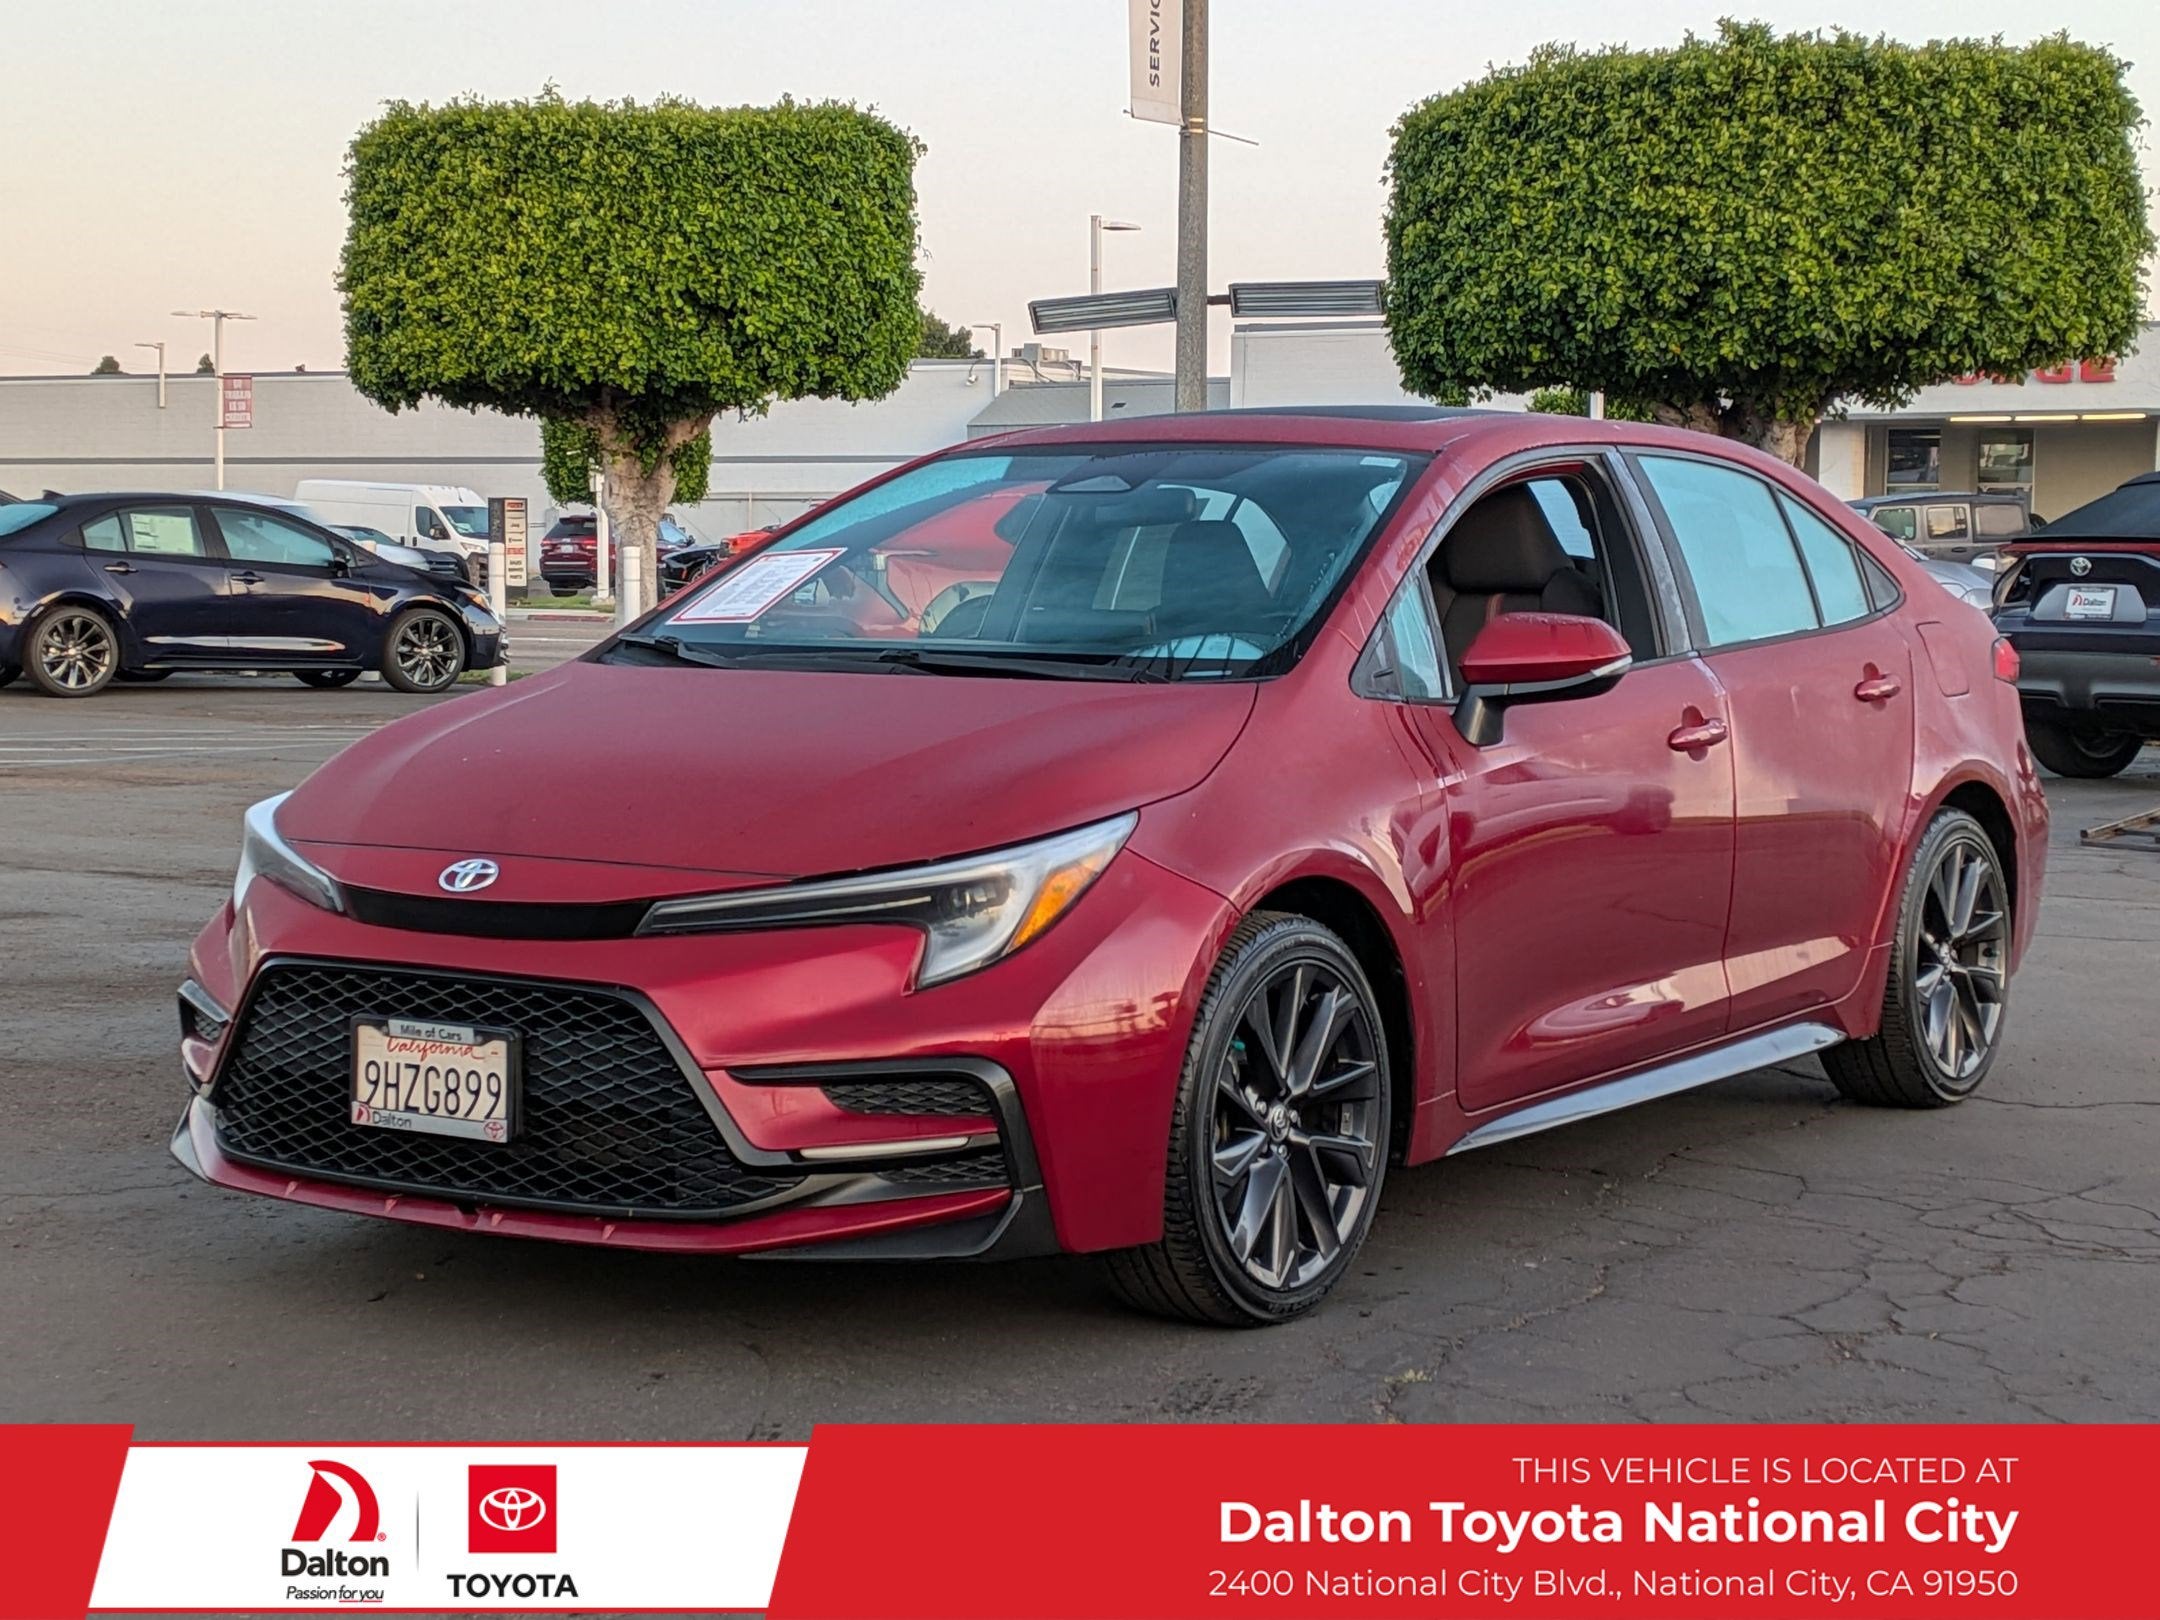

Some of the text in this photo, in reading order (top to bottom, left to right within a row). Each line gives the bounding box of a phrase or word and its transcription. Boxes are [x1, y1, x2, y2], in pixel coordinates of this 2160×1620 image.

[400, 1024, 462, 1041] Mile of Cars
[387, 1037, 485, 1061] California
[365, 1060, 501, 1119] 9HZG899
[372, 1111, 412, 1128] Dalton
